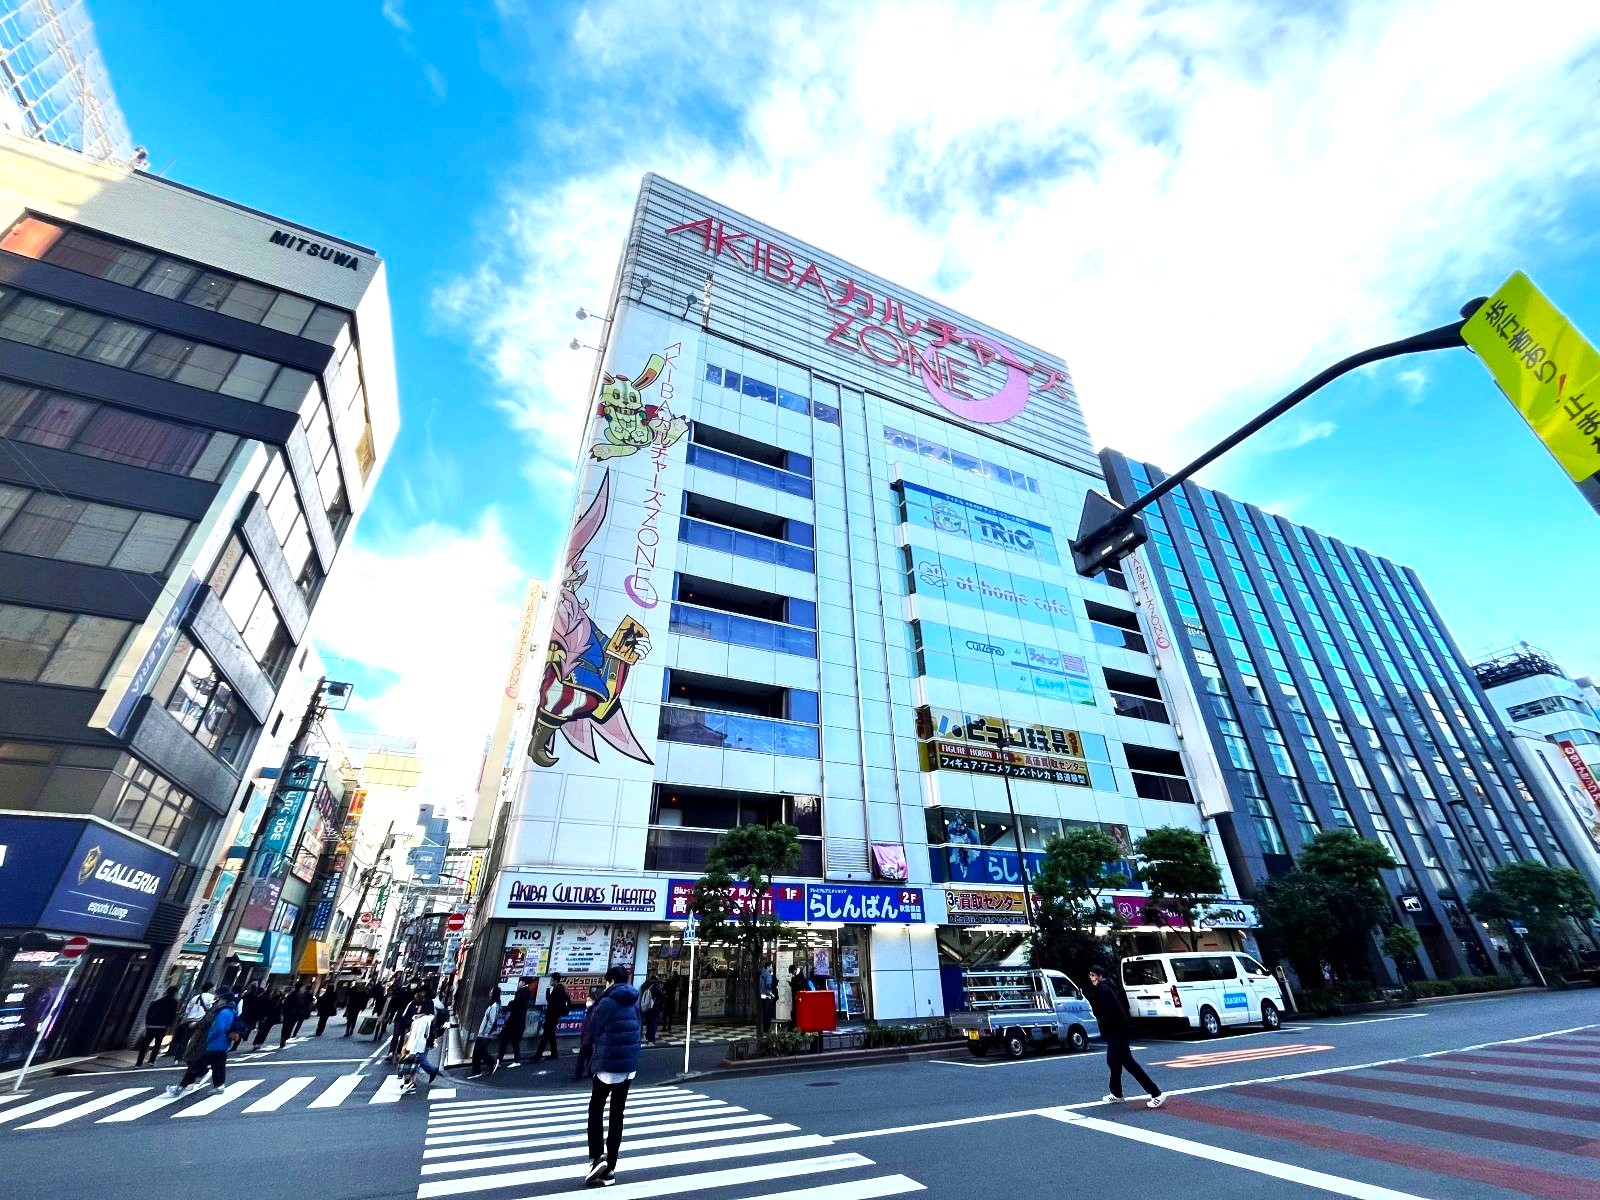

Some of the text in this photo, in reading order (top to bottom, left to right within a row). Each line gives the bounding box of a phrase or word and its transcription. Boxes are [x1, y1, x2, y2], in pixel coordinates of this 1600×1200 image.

[269, 230, 358, 271] MITSUWA
[825, 305, 973, 399] ZONE
[95, 858, 160, 895] GALLERIA
[509, 880, 657, 905] AKIBA CULTURES THEATER
[785, 887, 797, 900] 1F
[902, 892, 917, 904] 2F
[947, 891, 1023, 910] 3F 買取センター
[88, 900, 128, 919] esports Lounge
[809, 893, 898, 919] らしんばん
